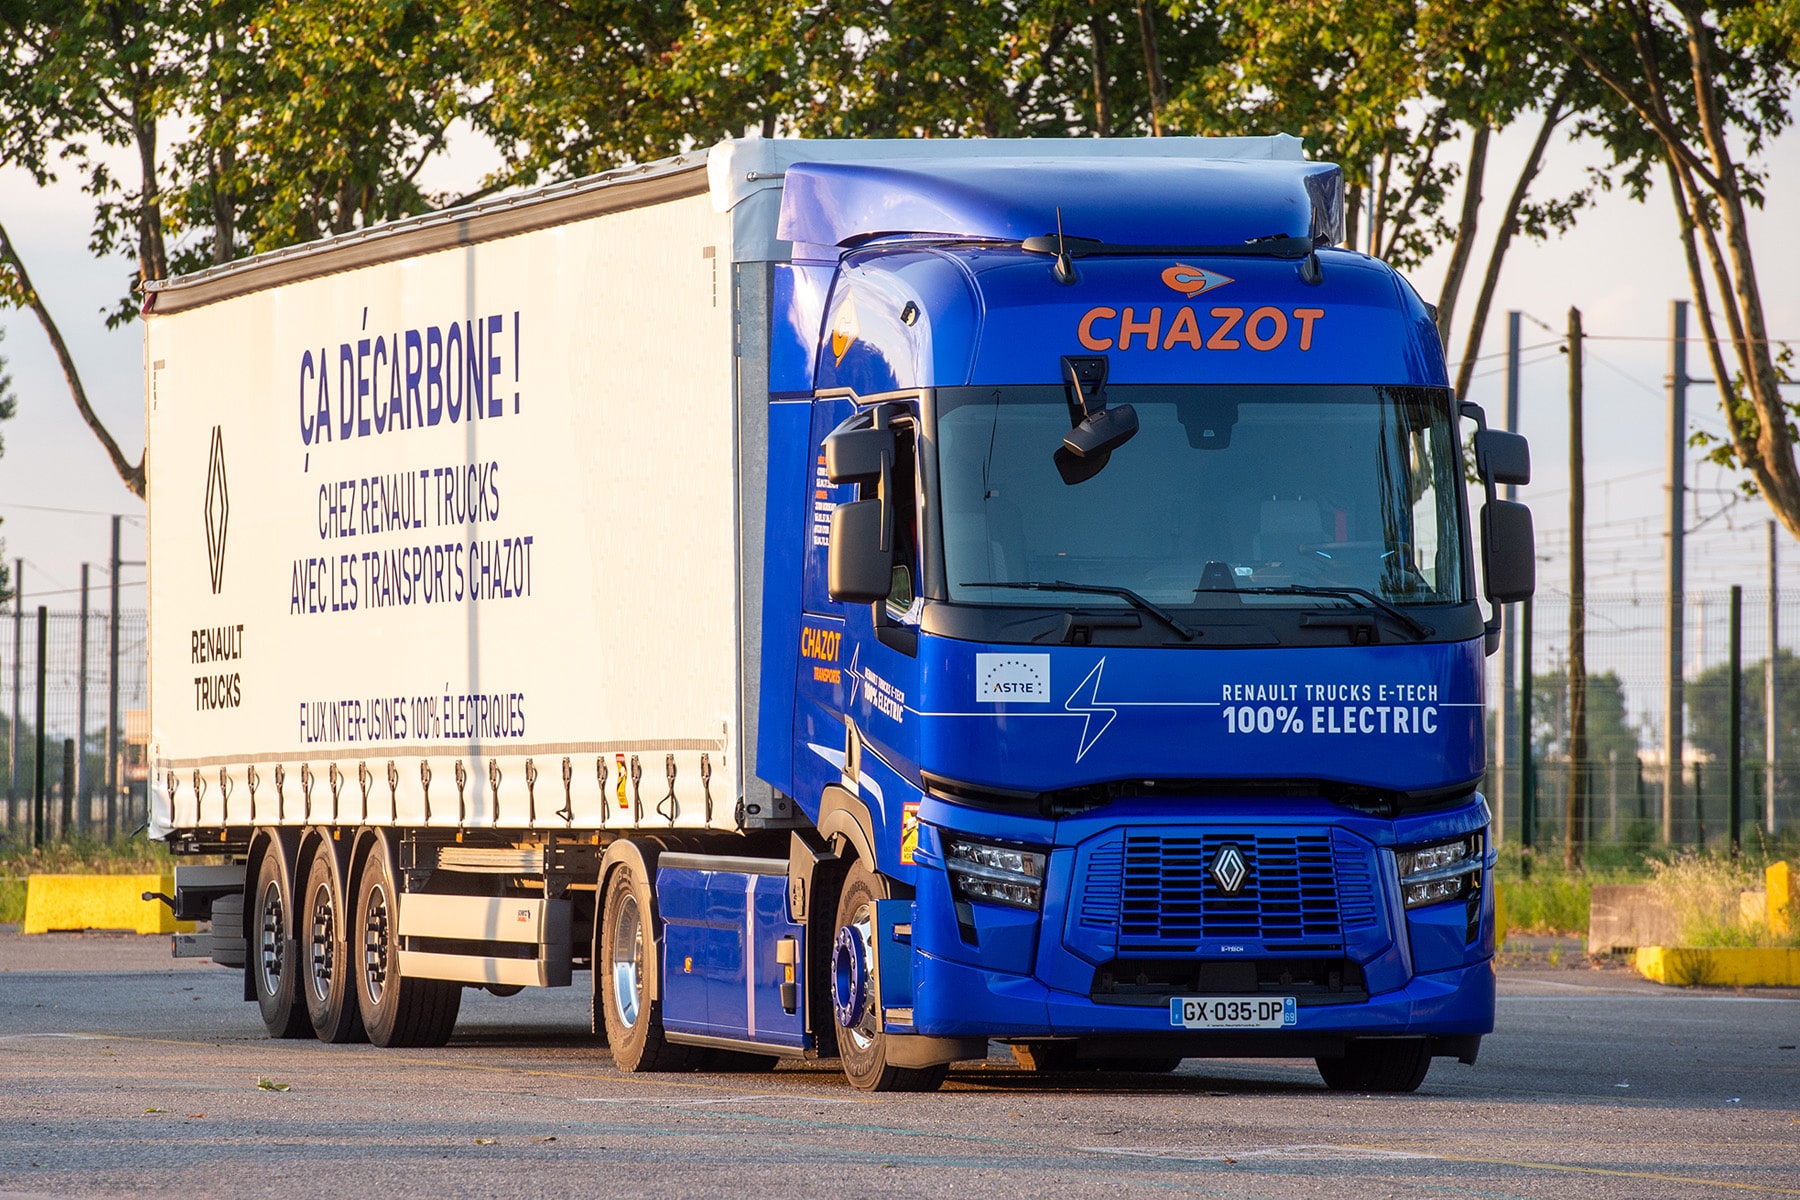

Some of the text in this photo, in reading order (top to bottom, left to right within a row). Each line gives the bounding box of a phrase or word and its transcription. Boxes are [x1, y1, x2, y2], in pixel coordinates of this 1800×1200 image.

[1078, 306, 1325, 352] CHAZOT
[300, 348, 332, 473] ÇA
[340, 307, 503, 441] DÉCARBONE
[318, 461, 500, 540] CHEZ RENAULT TRUCKS
[290, 536, 534, 616] AVEC LES TRANSPORTS CHAZOT
[191, 624, 244, 665] RENAULT
[801, 626, 841, 662] CHAZOT
[194, 672, 241, 712] TRUCKS
[813, 666, 841, 684] TRANSPORTS
[993, 682, 1034, 694] ASTRE
[1222, 683, 1439, 702] RENAULT TRUCKS E-TECH
[300, 682, 526, 743] FLUX INTER-USINES 100% ÉLECTRIQUES
[878, 690, 904, 724] ELECTRIC
[1222, 706, 1439, 734] 100% ELECTRIC
[1183, 1001, 1283, 1022] GX-035-DP
[1284, 1012, 1295, 1022] 69
